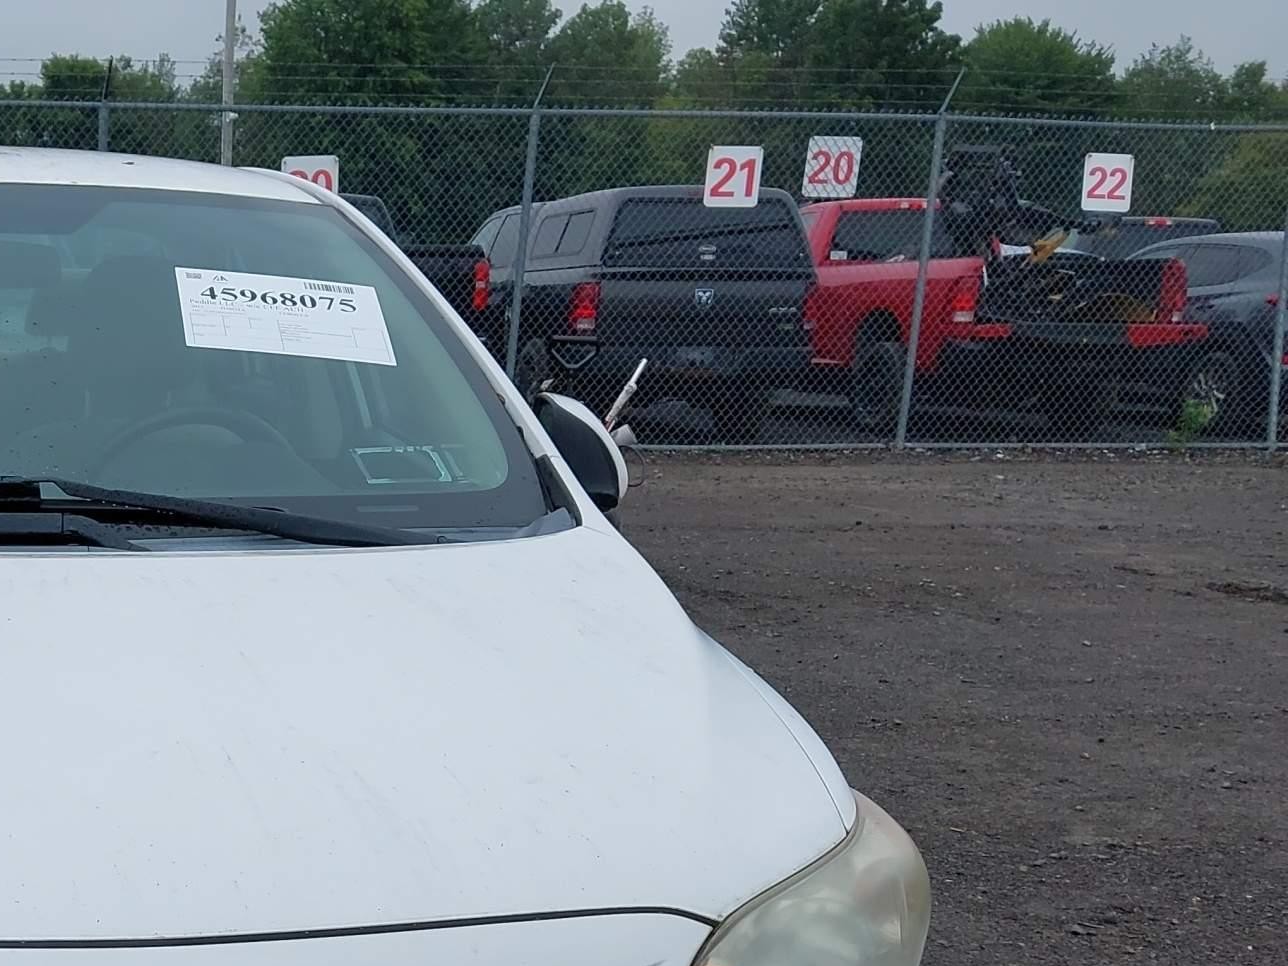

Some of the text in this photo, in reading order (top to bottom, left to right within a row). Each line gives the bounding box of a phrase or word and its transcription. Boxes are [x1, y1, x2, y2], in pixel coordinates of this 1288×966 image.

[710, 157, 756, 197] 21
[808, 150, 855, 185] 20
[1086, 166, 1128, 200] 22
[200, 286, 357, 313] 45968075
